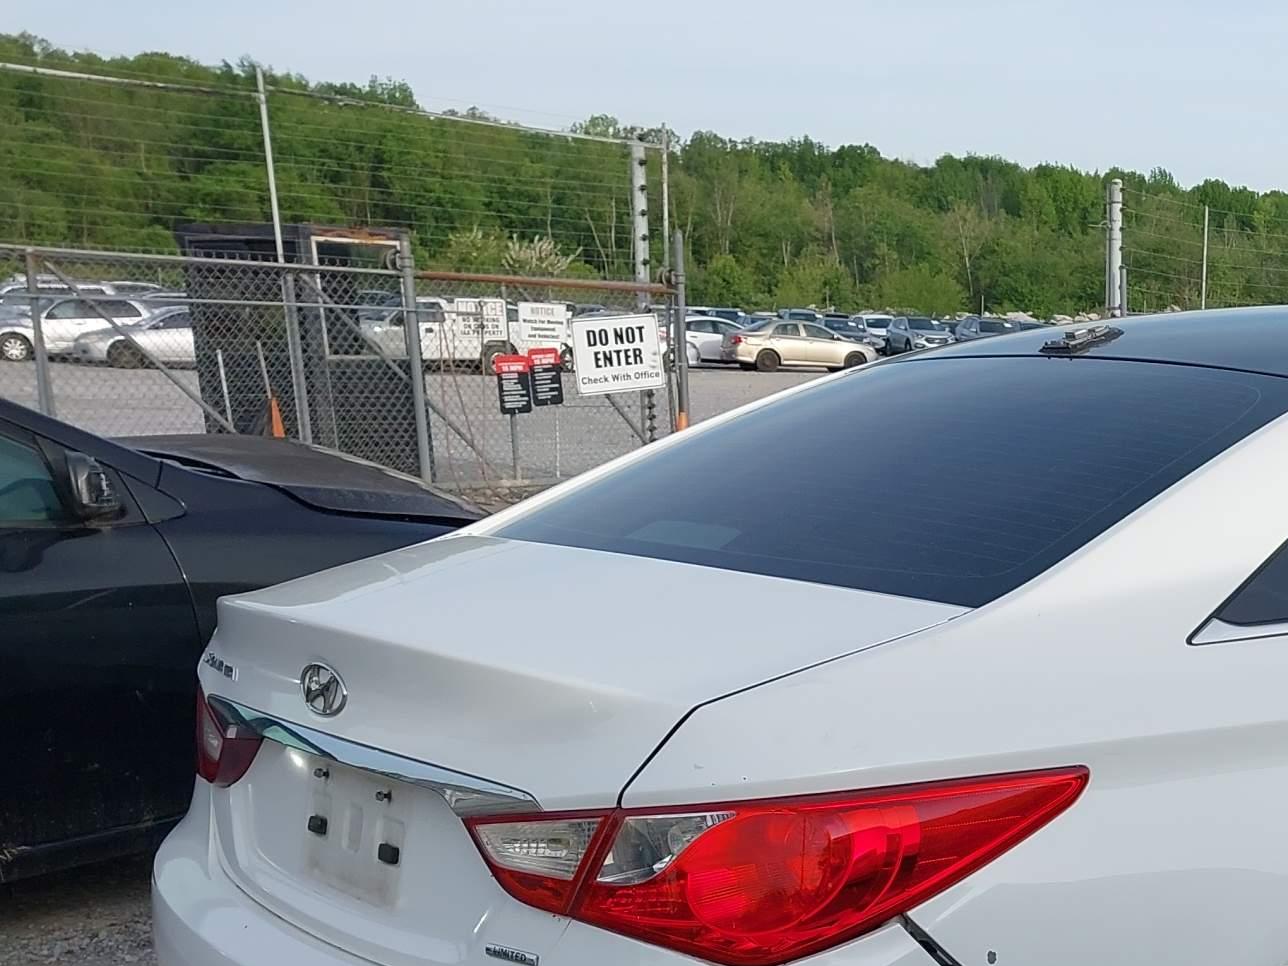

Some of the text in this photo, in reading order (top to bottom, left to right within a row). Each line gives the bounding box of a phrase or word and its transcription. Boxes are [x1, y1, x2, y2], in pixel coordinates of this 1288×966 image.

[530, 306, 554, 316] NOTICE
[585, 325, 645, 347] DO NOT
[593, 347, 644, 369] ENTER
[581, 370, 660, 385] Check With Office
[492, 946, 527, 961] LIMITED
